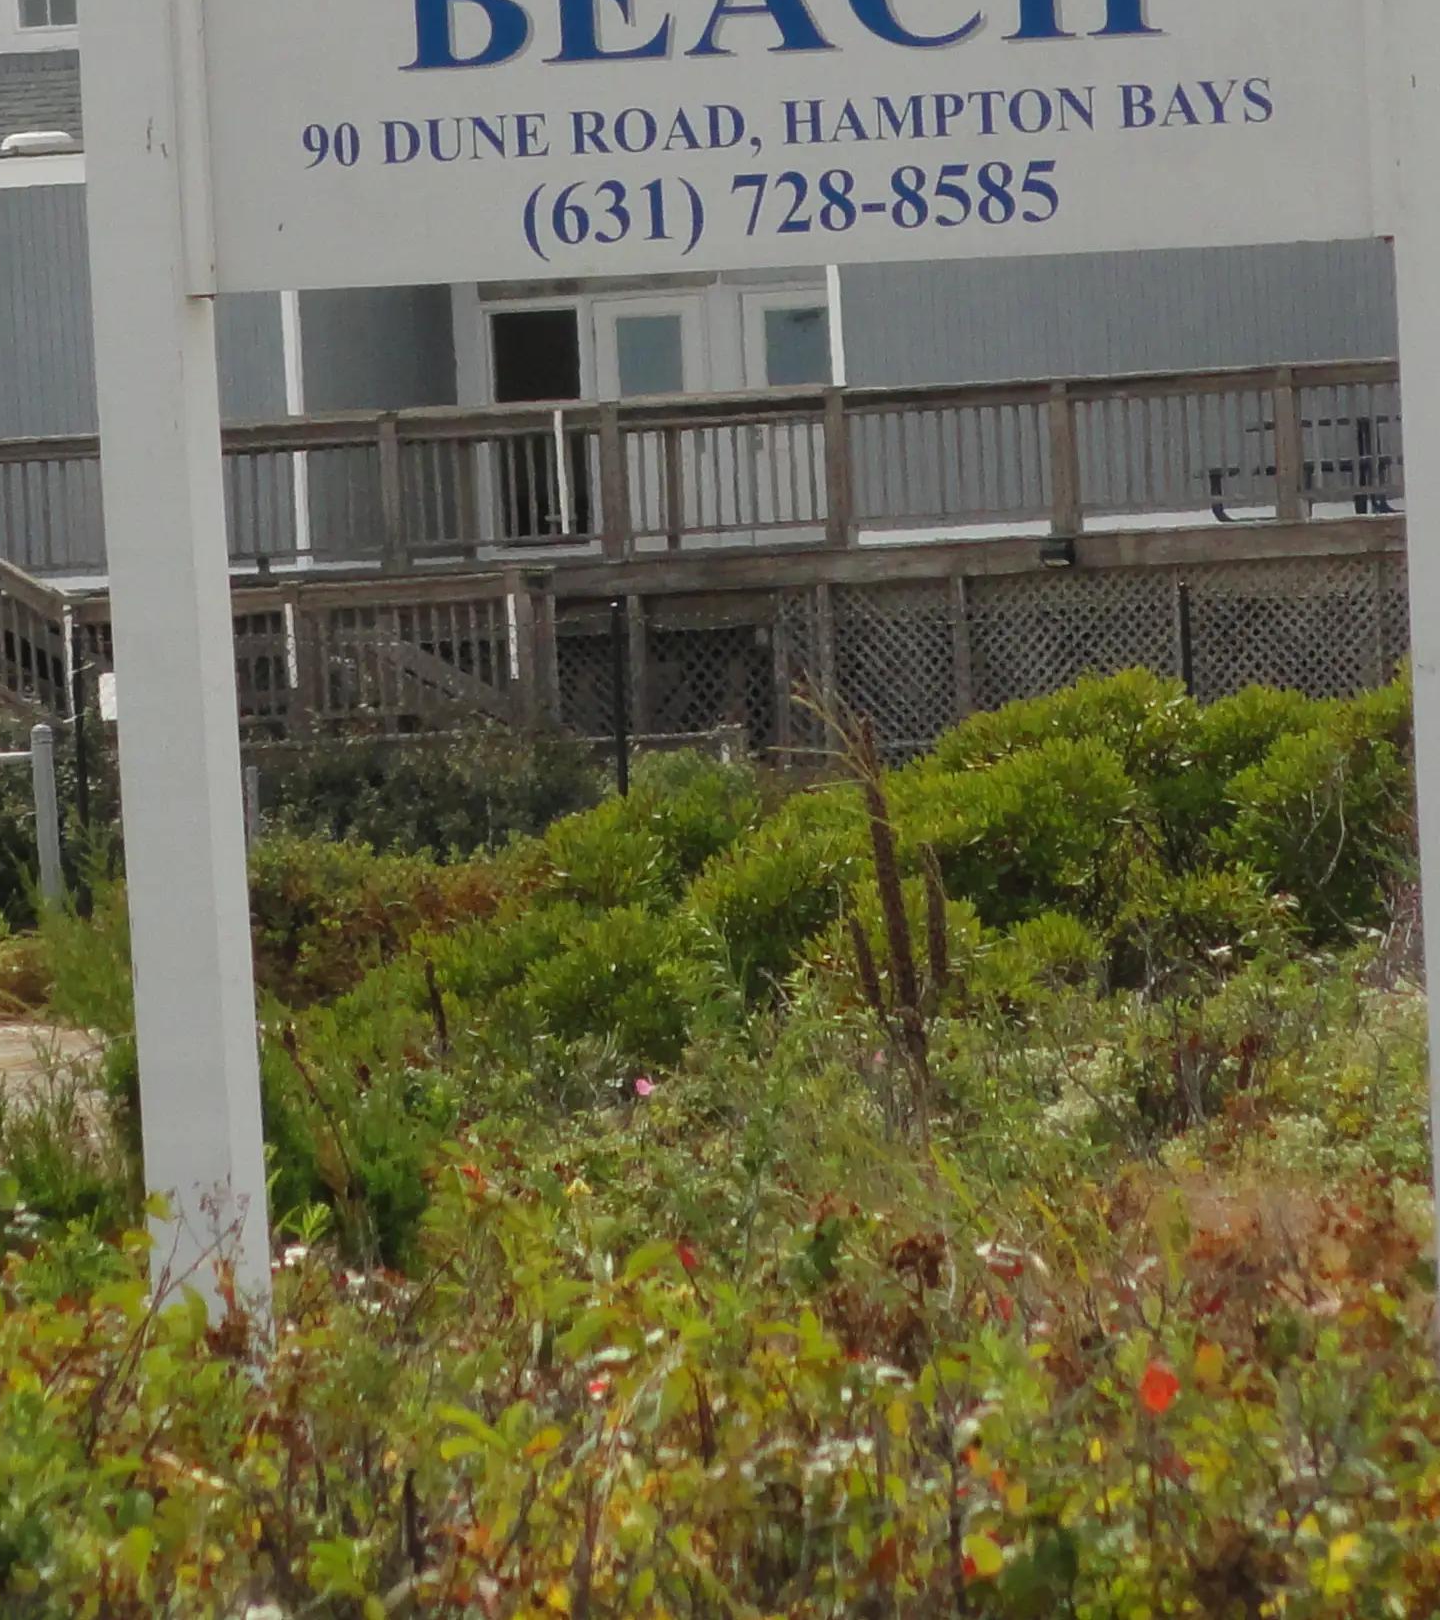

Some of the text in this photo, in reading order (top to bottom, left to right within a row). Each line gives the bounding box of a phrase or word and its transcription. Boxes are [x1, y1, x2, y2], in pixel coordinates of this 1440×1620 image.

[302, 78, 1275, 169] 90 DUNE ROAD, HAMPTON BAYS
[523, 159, 1061, 260] (631) 728-8585
